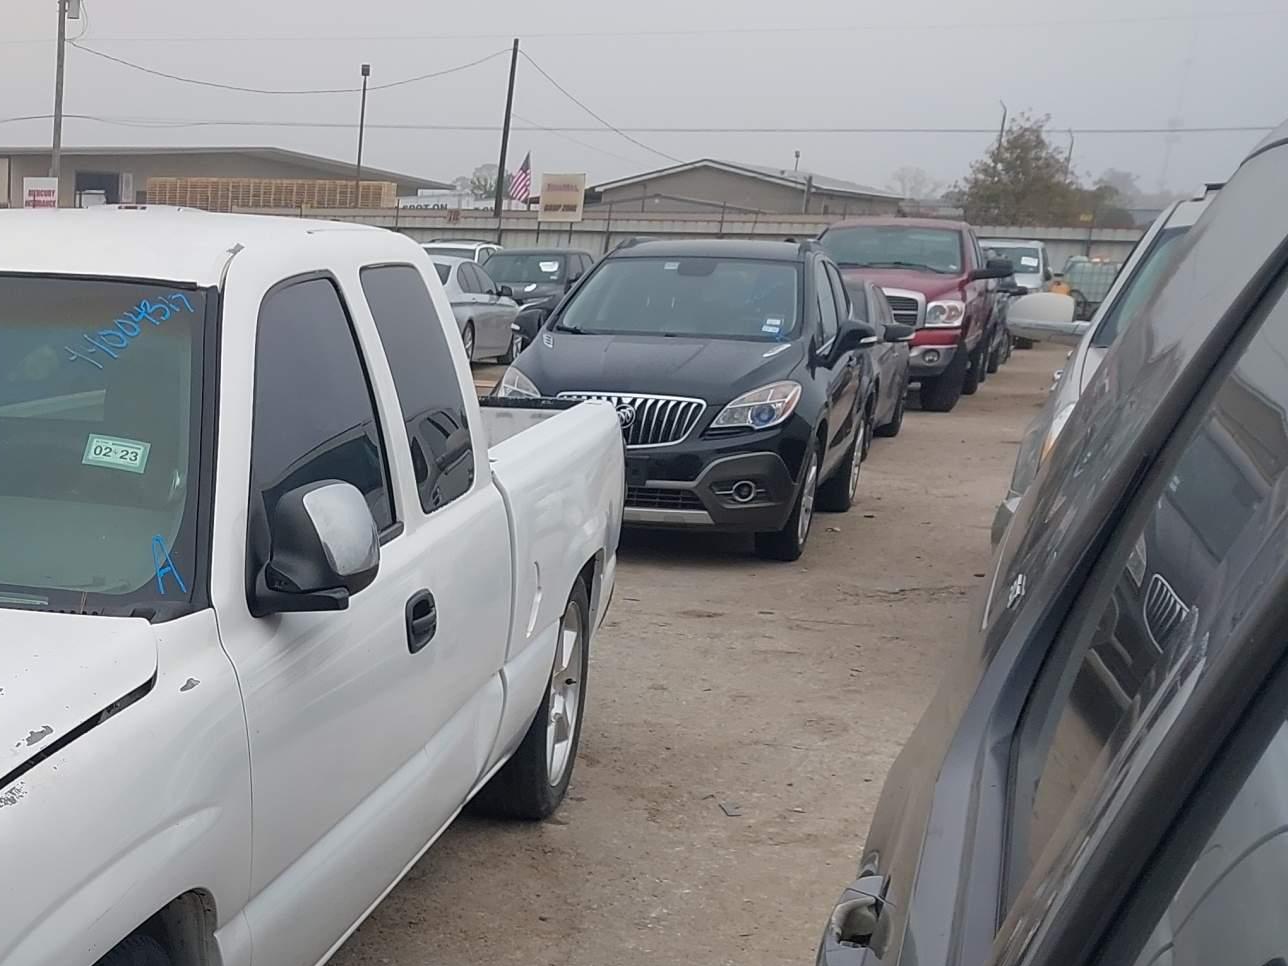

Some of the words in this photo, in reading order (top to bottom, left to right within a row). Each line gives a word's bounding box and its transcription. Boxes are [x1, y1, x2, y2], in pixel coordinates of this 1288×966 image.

[93, 445, 113, 458] 02
[119, 449, 139, 462] 23
[151, 533, 188, 595] A
